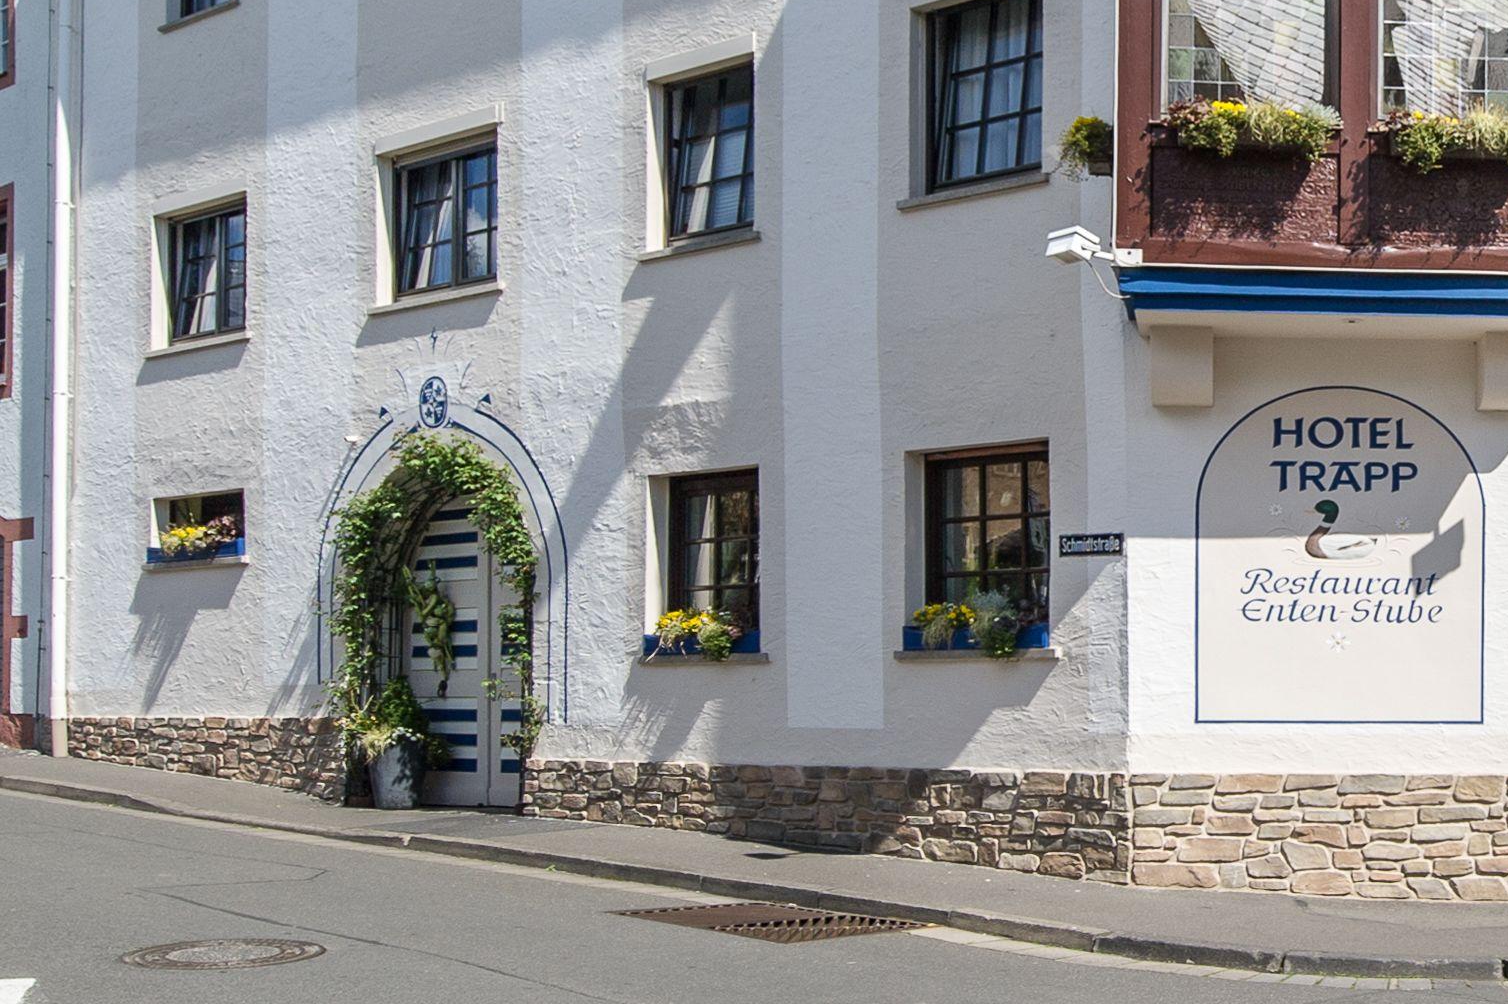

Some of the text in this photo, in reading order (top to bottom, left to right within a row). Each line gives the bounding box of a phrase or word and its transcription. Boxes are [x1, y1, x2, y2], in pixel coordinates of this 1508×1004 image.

[1272, 417, 1415, 449] HOTEL
[1269, 461, 1418, 493] TRAPP
[1061, 536, 1120, 553] Schmidtstraße
[1240, 568, 1440, 595] Restaurant
